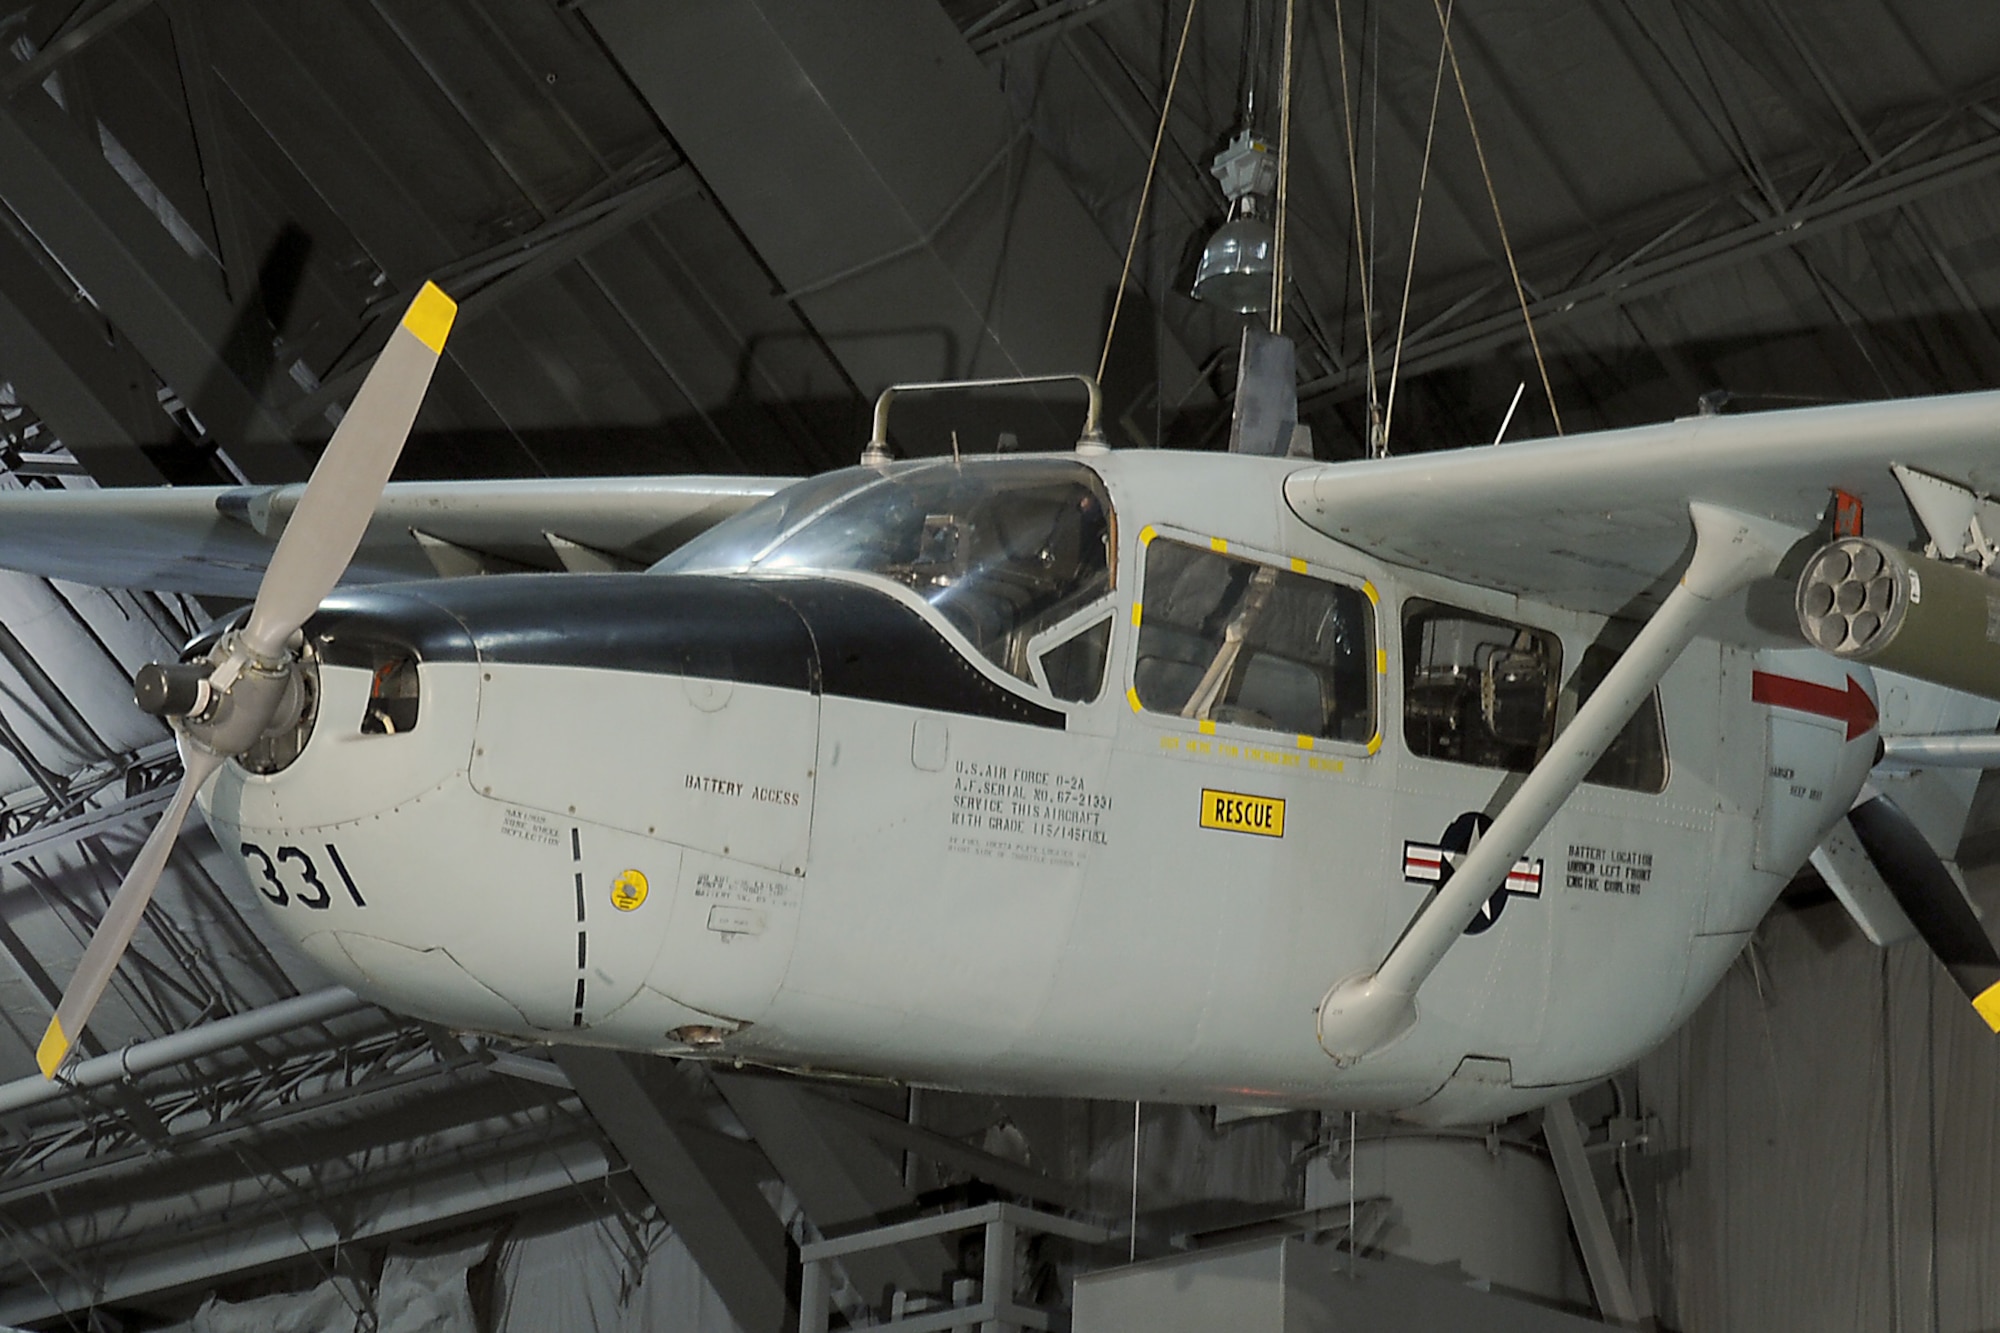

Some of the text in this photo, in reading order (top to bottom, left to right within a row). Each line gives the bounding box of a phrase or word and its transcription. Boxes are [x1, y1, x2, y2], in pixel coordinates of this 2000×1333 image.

[685, 774, 799, 806] BATTERY ACCESS
[1013, 768, 1050, 786] FORCE
[951, 812, 982, 828] WITH
[988, 817, 1025, 833] GRADE
[953, 795, 1100, 826] SERVICE THIS AIRCRAFT
[1215, 798, 1273, 828] RESCUE
[1568, 845, 1653, 867] BATTERY LOCATION
[241, 842, 367, 909] 331
[1567, 861, 1595, 875] UNDER
[1600, 864, 1621, 878] LEFT
